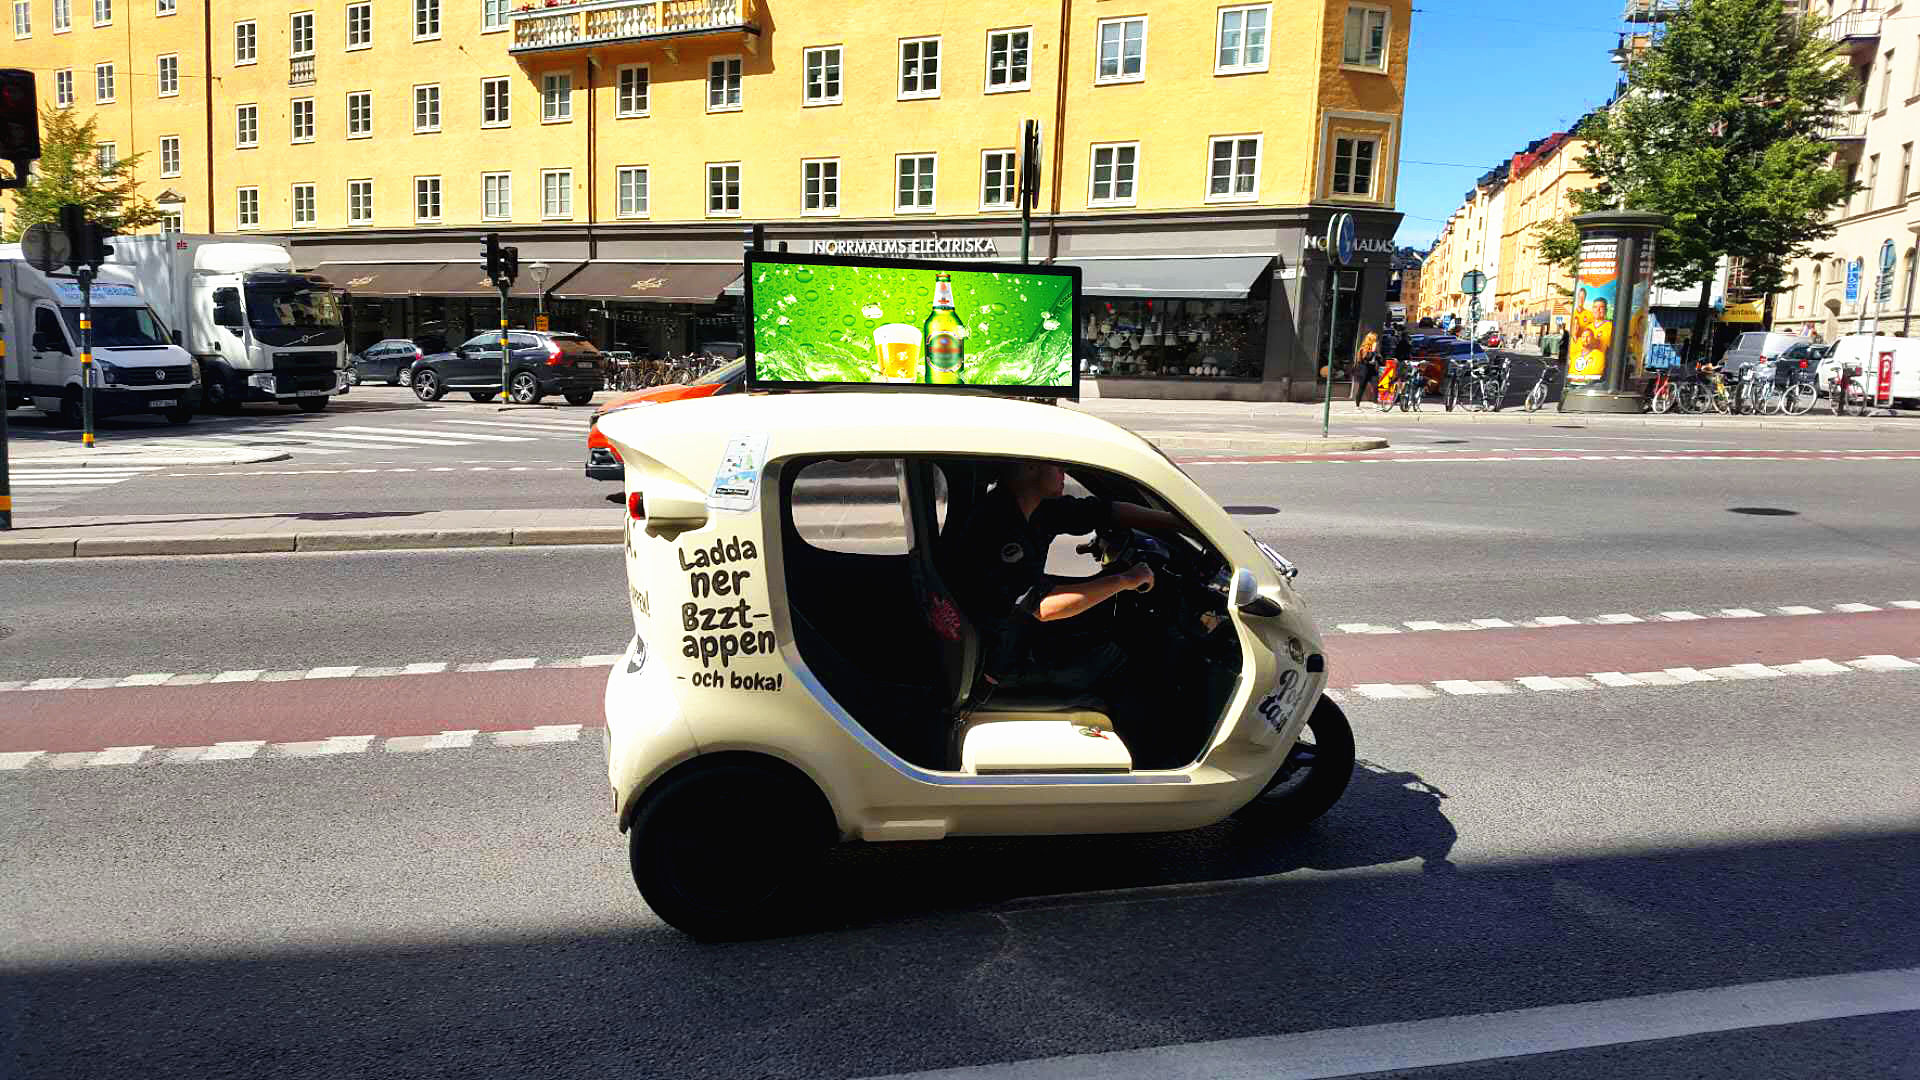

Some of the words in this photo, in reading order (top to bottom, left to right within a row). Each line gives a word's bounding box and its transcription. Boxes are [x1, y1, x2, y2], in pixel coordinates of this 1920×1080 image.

[911, 237, 996, 253] ELEKTRISKA
[679, 536, 757, 570] Ladda
[690, 569, 751, 598] ner
[682, 630, 776, 668] appen
[692, 670, 724, 689] och
[731, 671, 782, 691] boka!
